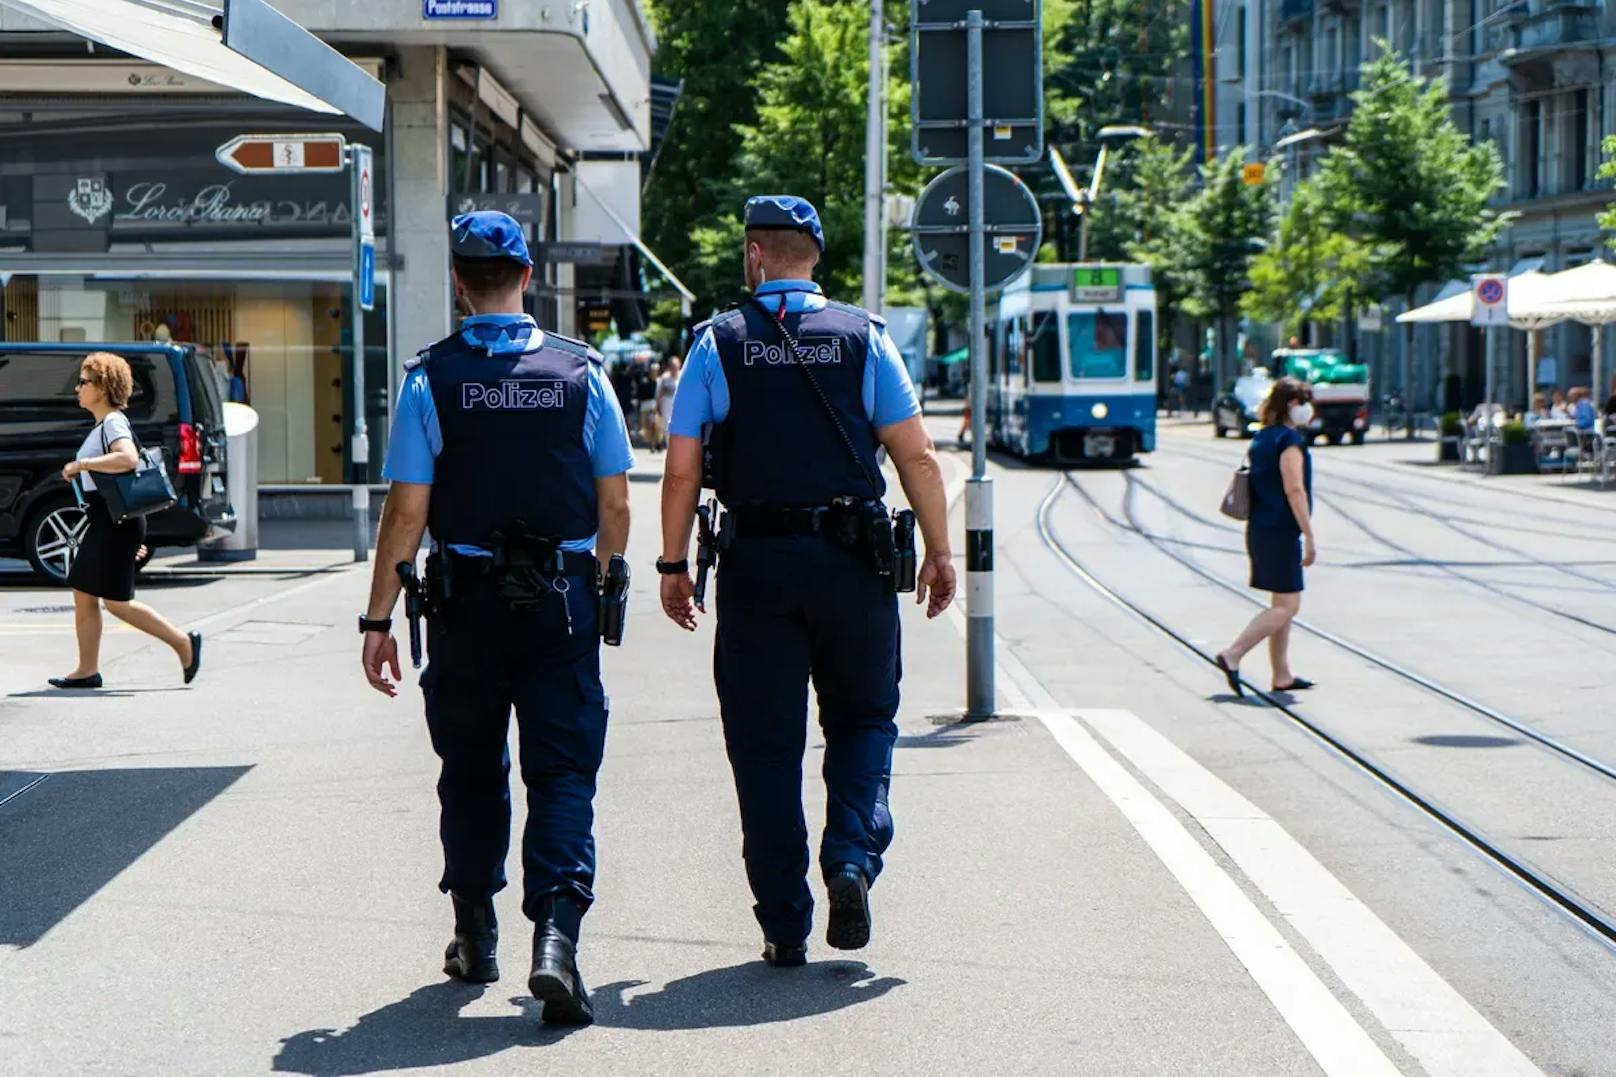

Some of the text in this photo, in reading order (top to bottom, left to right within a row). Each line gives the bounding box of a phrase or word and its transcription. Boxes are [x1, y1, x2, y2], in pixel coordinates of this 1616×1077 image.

[114, 181, 187, 220] Loro
[744, 338, 841, 366] Polizei
[462, 381, 564, 409] Polizei
